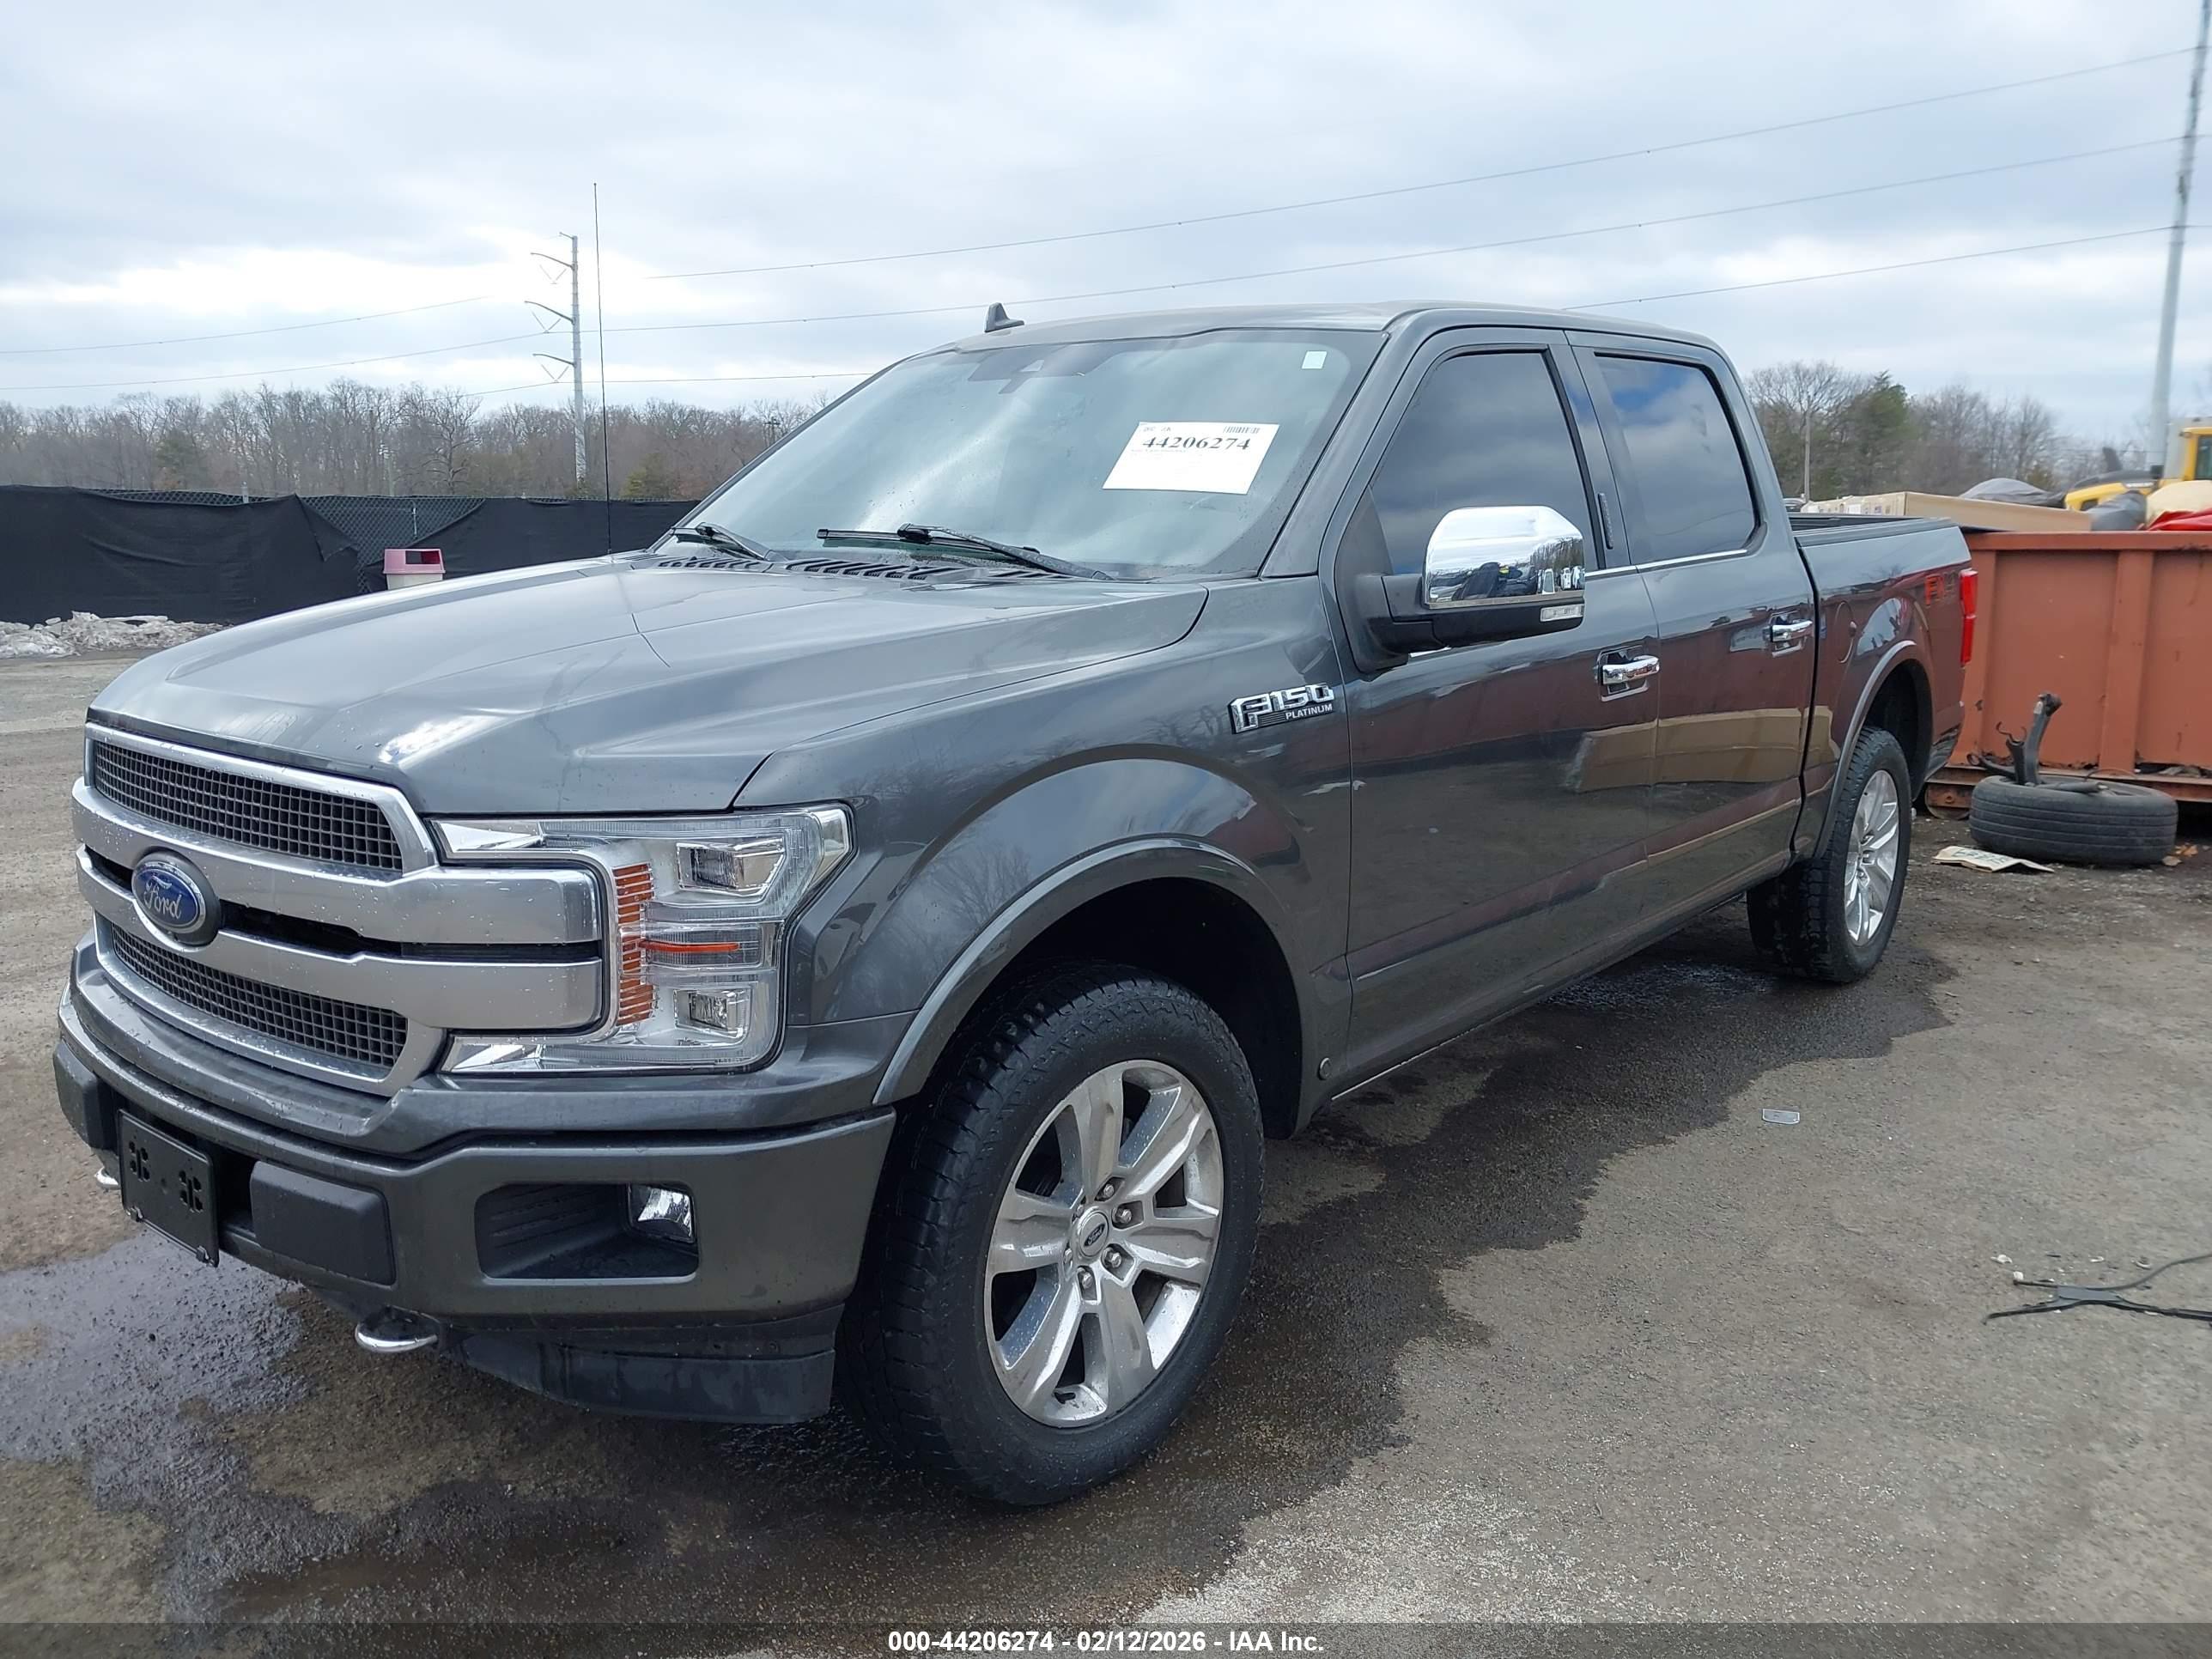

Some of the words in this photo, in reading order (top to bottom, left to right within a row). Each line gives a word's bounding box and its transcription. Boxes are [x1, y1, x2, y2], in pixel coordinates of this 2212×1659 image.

[1141, 436, 1251, 451] 44206274
[1285, 703, 1333, 720] PLATINUM
[143, 875, 182, 920] Ford
